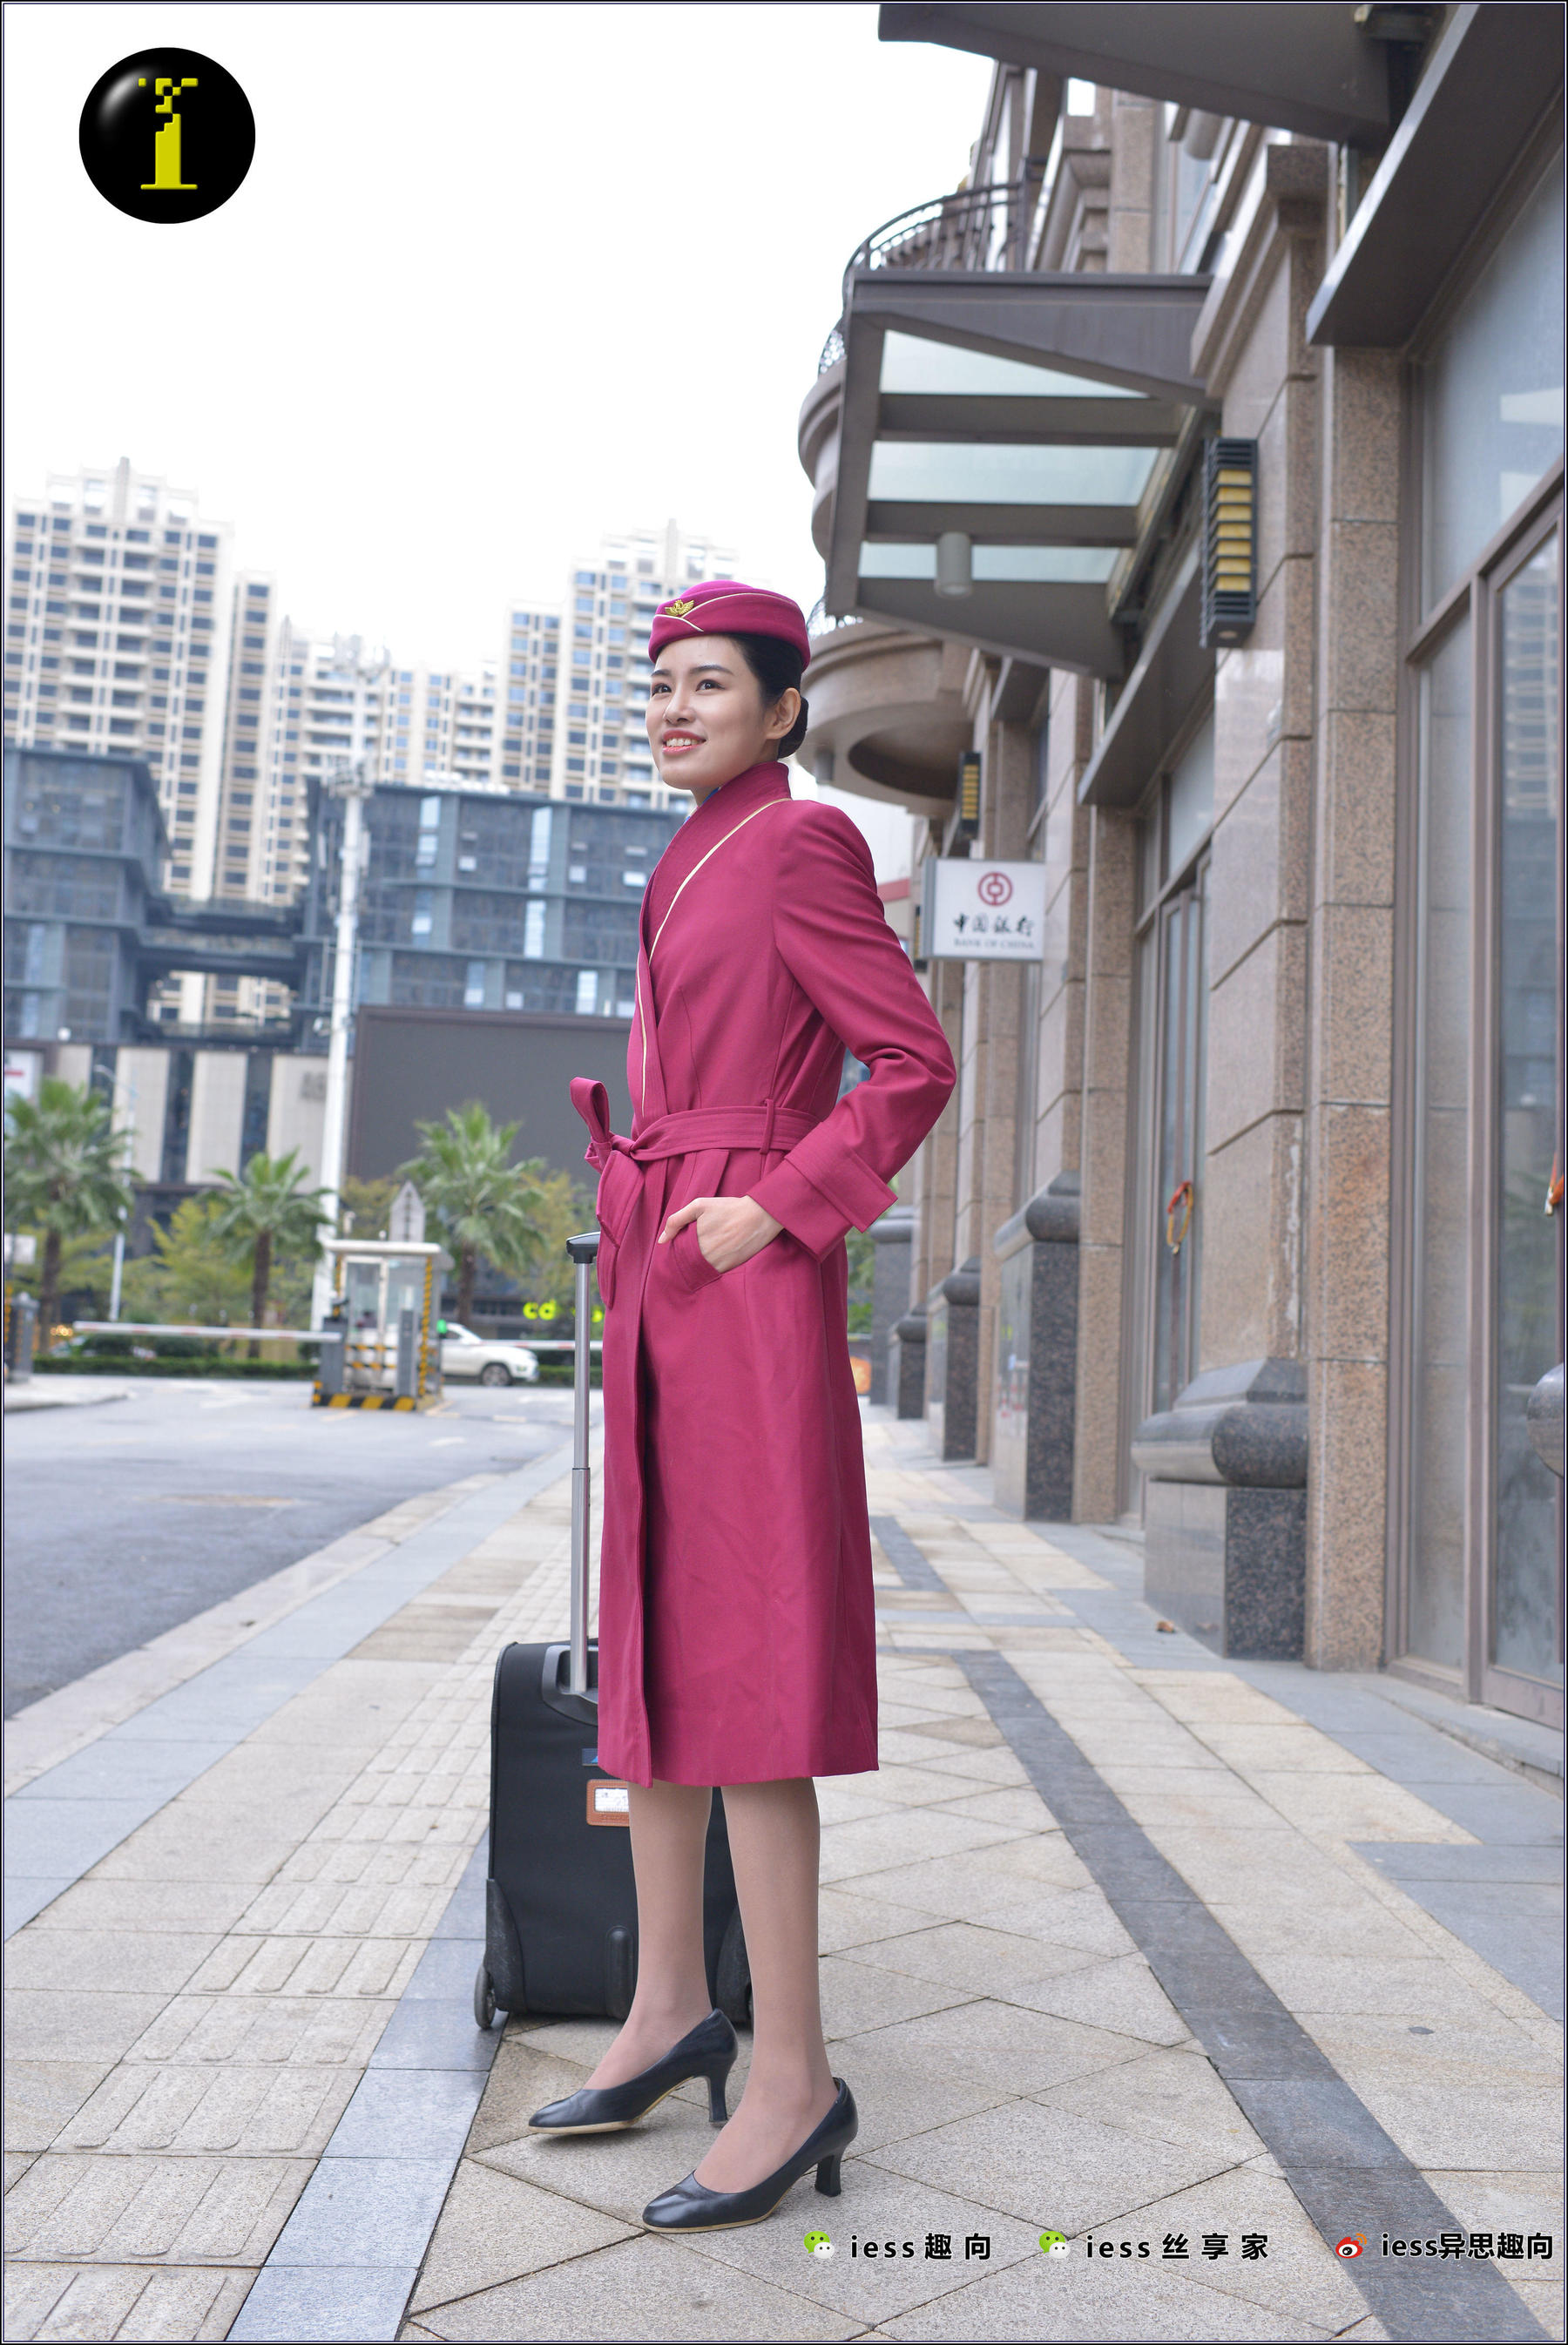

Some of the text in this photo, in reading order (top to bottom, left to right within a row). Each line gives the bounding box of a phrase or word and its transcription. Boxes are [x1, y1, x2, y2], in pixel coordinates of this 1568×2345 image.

[954, 938, 1035, 949] BANK OF CHINA
